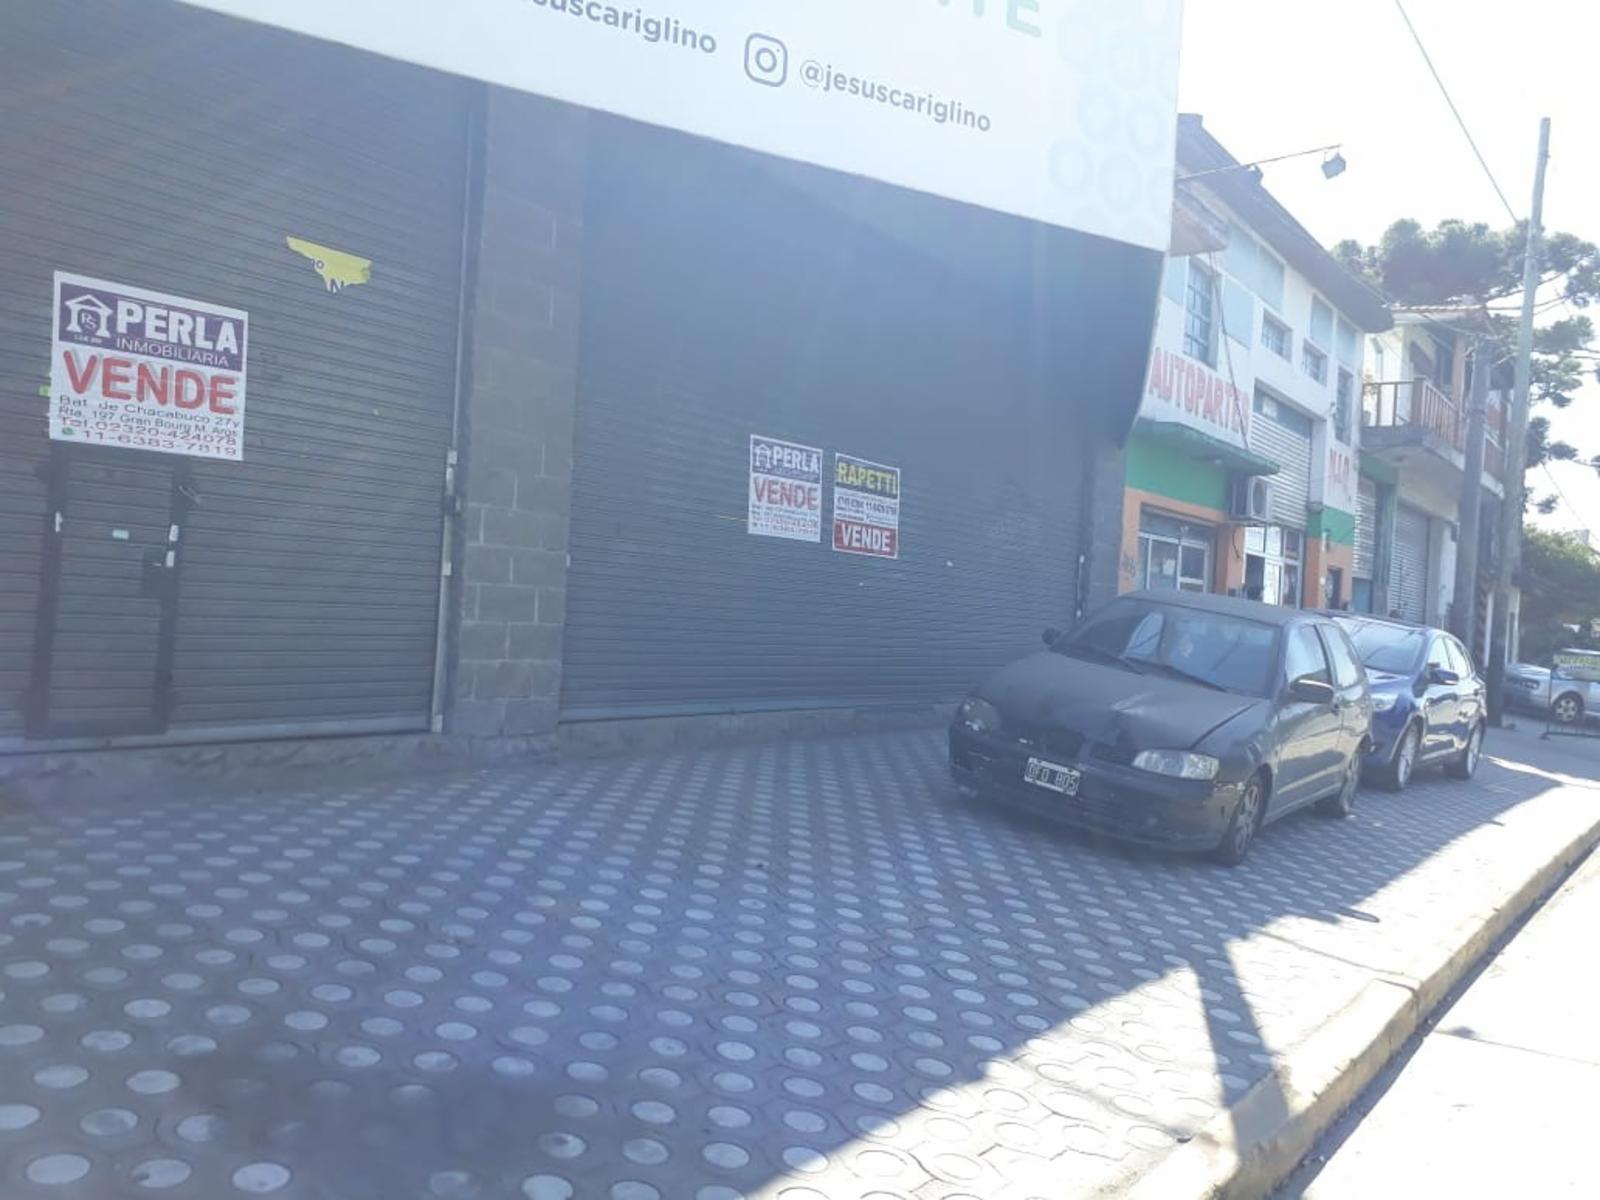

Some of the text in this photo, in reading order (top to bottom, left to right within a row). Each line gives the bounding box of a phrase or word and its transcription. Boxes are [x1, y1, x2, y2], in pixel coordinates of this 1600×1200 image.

[799, 60, 991, 131] @jesuscariglino
[116, 299, 238, 355] PERLA
[116, 336, 229, 367] INMOBILIARIA
[63, 350, 235, 415] VENDE
[120, 413, 151, 426] Gran
[155, 418, 191, 434] Bourg
[124, 403, 210, 424] Chacabuco
[773, 446, 819, 474] PERLA
[753, 477, 819, 511] VENDE
[837, 461, 897, 496] RAPETTI
[841, 523, 891, 552] VENDE
